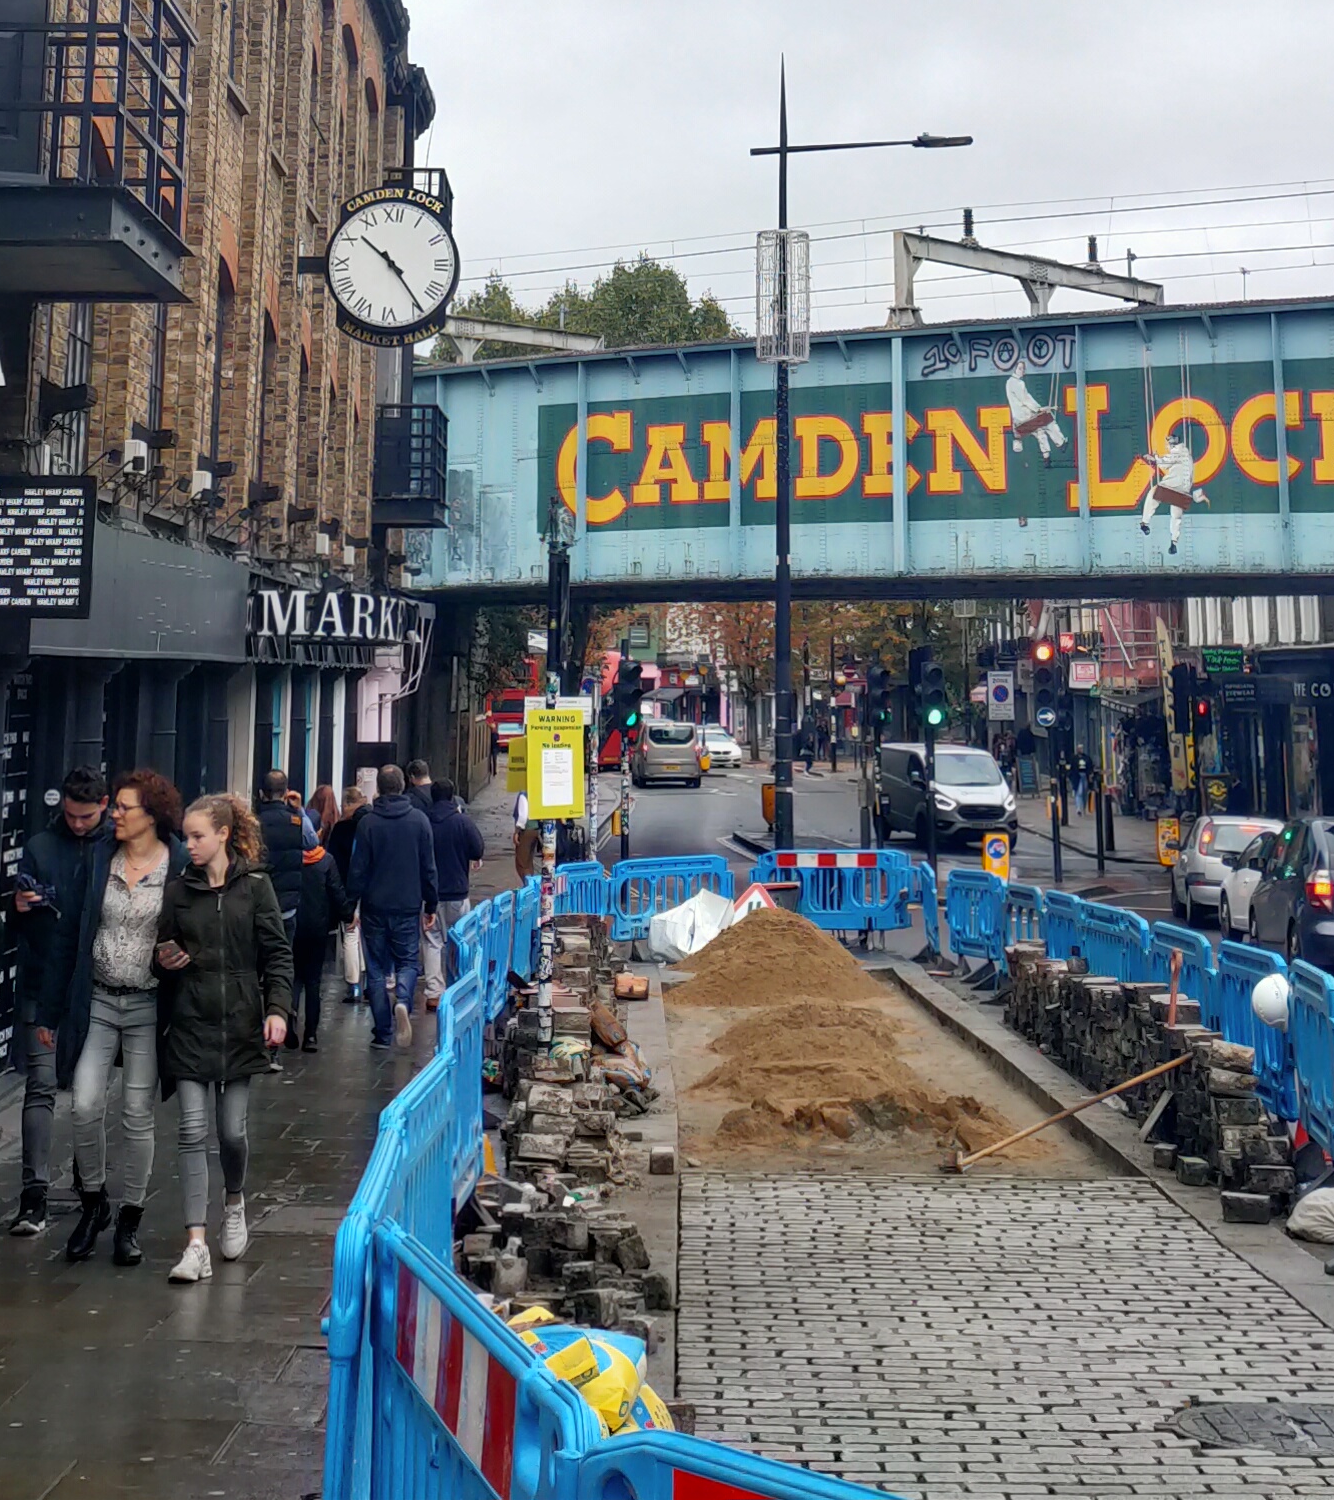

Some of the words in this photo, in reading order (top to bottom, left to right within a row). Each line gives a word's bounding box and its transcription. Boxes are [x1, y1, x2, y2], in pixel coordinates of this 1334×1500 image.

[346, 188, 405, 212] CAMDEN
[407, 190, 445, 213] LOCK
[383, 208, 404, 223] XII
[342, 321, 400, 345] MARKET
[403, 323, 439, 344] HALL
[556, 405, 1013, 526] CAMDEN
[538, 715, 576, 723] WARNING
